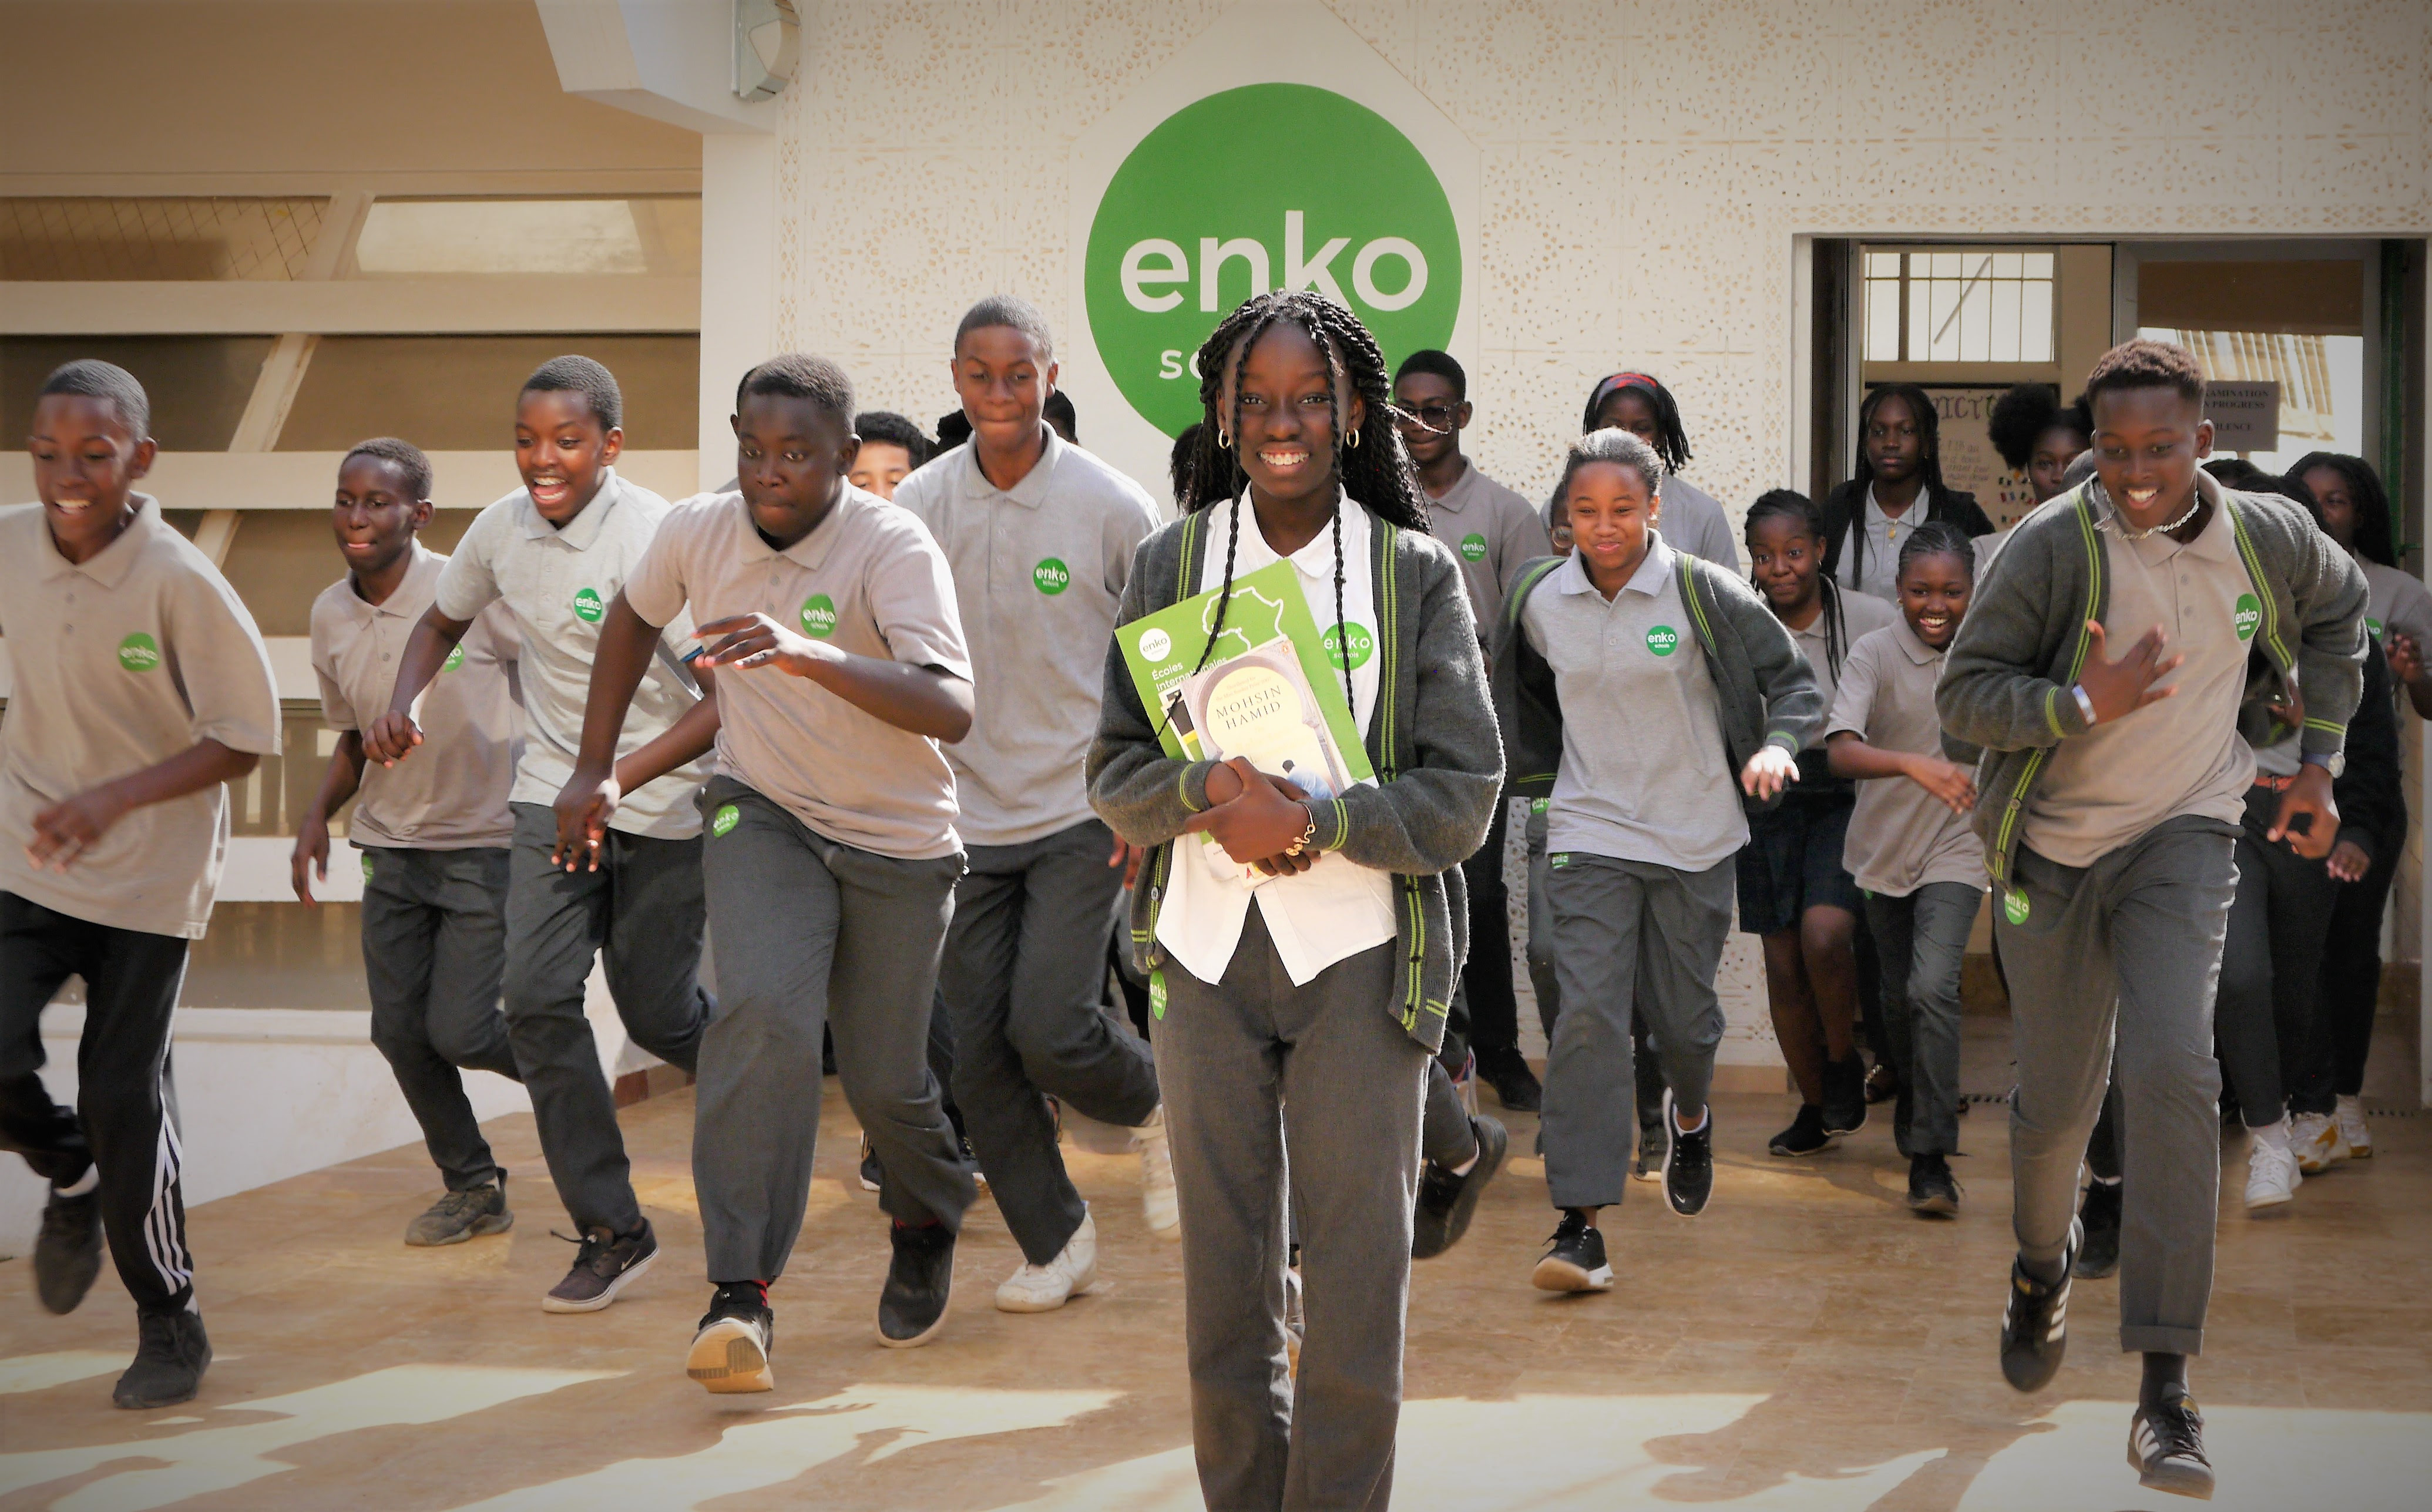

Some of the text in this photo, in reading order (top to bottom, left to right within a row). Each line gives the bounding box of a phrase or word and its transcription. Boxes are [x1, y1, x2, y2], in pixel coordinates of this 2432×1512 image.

[1120, 210, 1428, 313] enko
[1463, 542, 1485, 552] enko
[1036, 566, 1067, 583] enko
[575, 596, 602, 610] enko
[802, 607, 835, 623] enko
[2235, 608, 2258, 624] enko
[1143, 637, 1167, 652] enko
[1647, 632, 1675, 643] enko
[1151, 662, 1184, 681] Écoles
[1155, 657, 1228, 692] Internatinales
[1216, 685, 1281, 719] MOHSIN
[1226, 701, 1280, 730] HAMID
[2004, 892, 2028, 913] enko
[1150, 983, 1167, 1001] enko
